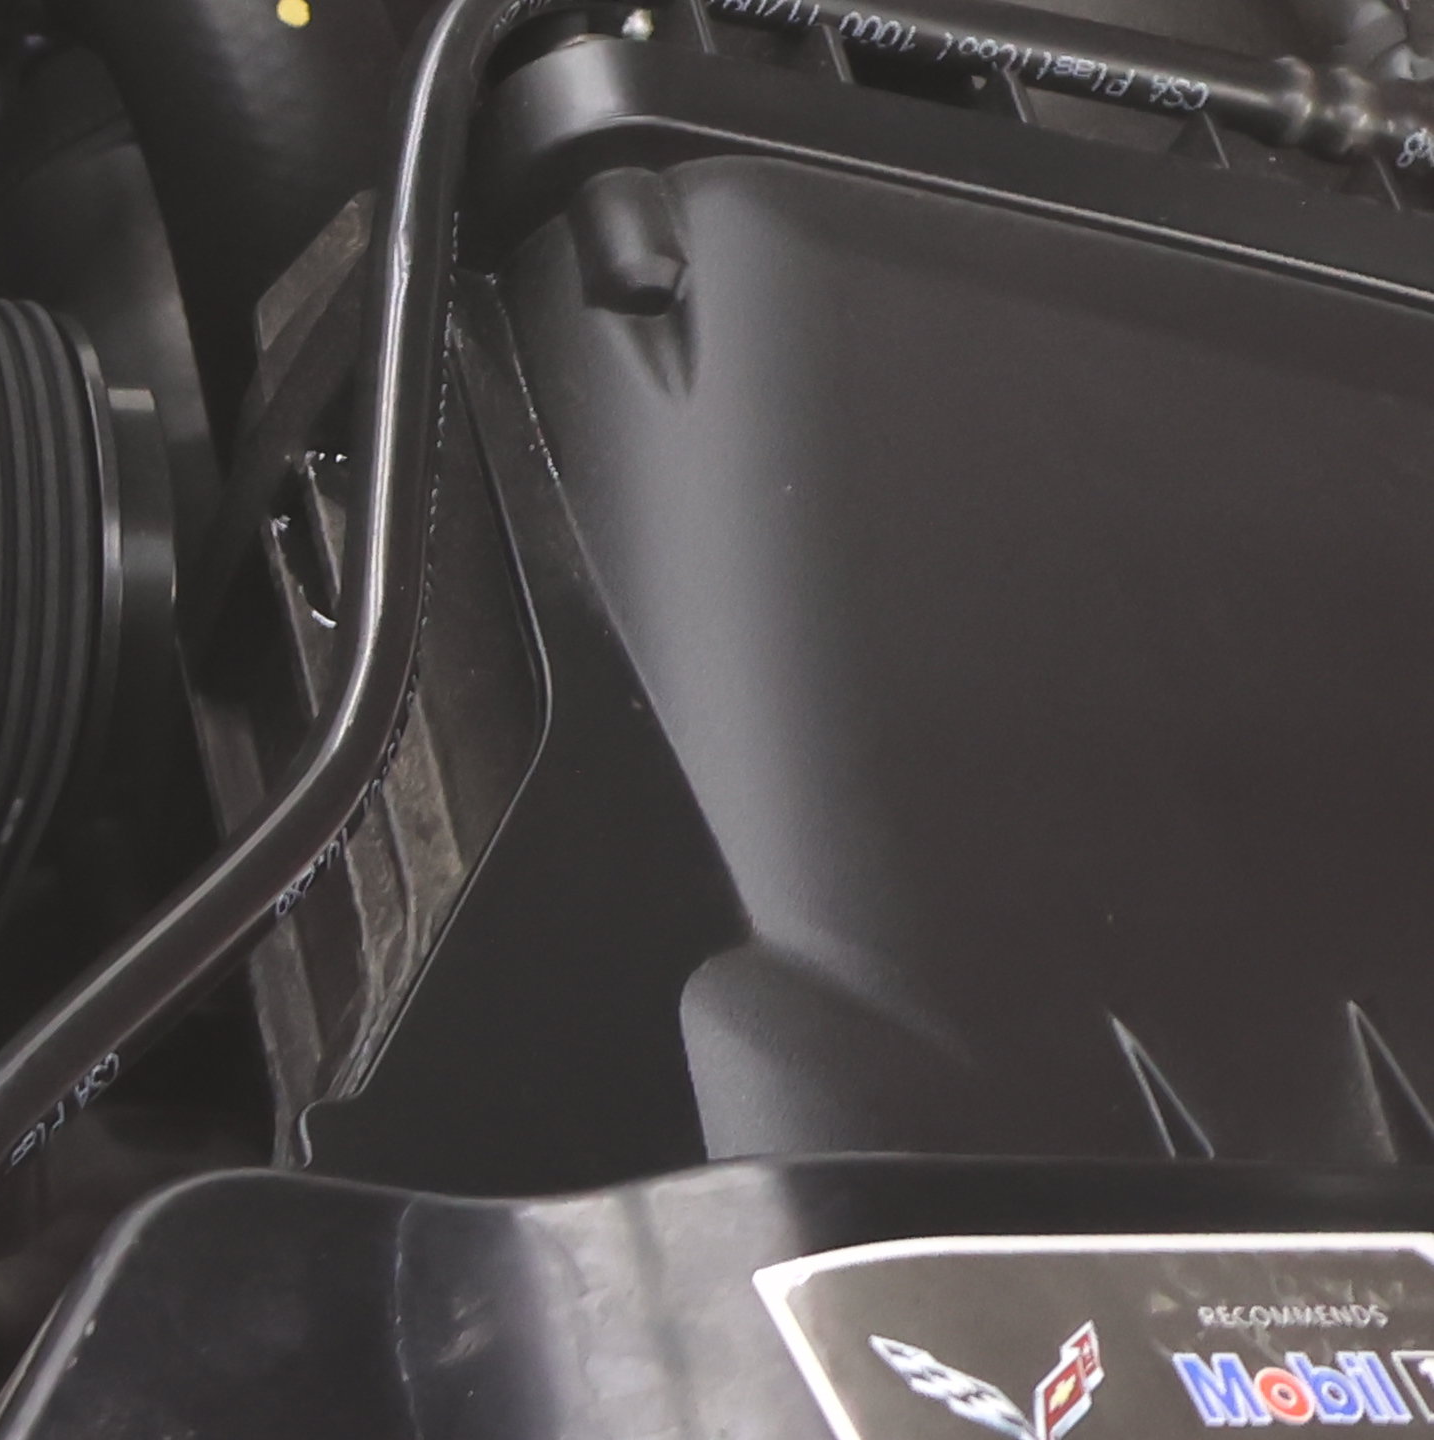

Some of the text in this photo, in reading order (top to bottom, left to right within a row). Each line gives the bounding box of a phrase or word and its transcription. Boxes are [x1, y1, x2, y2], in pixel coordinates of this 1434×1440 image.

[1148, 74, 1210, 112] CSA
[1198, 1304, 1390, 1329] RECOMMENDS
[1172, 1352, 1413, 1427] Mobil
